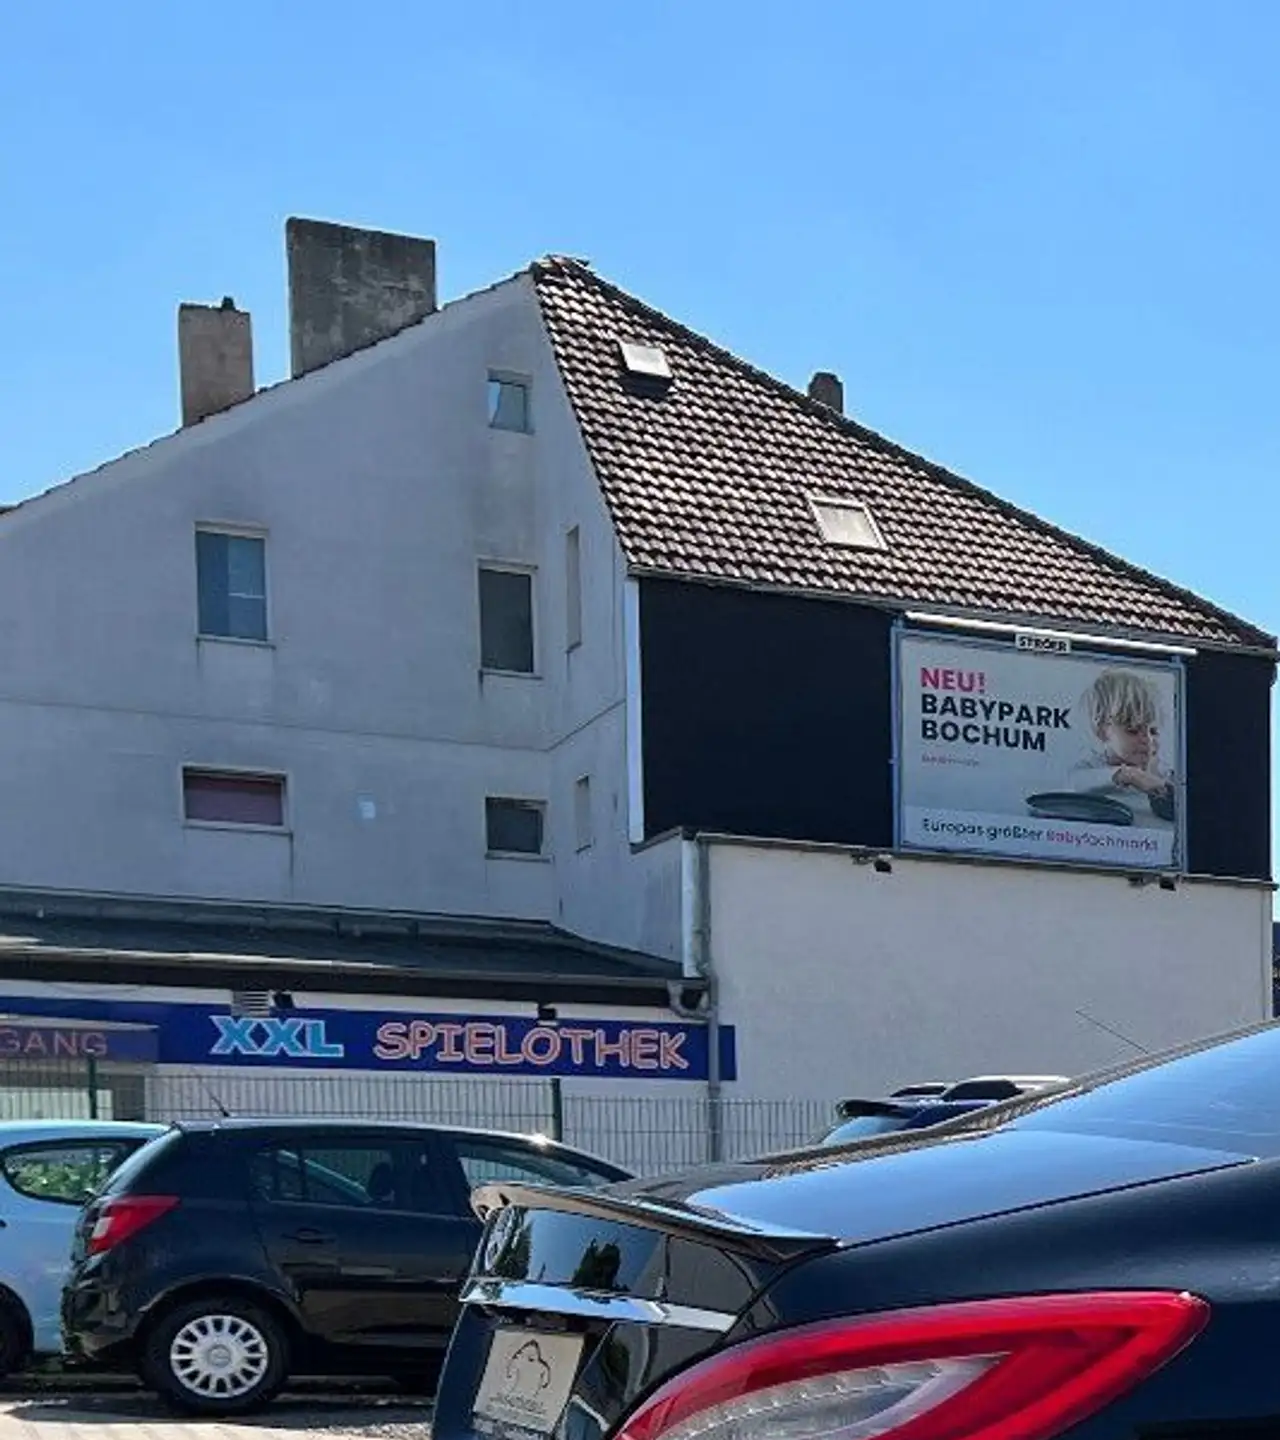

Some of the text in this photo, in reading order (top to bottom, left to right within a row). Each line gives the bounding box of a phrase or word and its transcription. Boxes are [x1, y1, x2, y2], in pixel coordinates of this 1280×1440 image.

[920, 667, 986, 694] NEU!
[921, 694, 1071, 729] BABYPARK
[921, 719, 1046, 752] BOCHUM
[923, 818, 985, 841] Europas
[989, 825, 1043, 843] größter
[209, 1015, 690, 1071] XXL SPIELOTHEK
